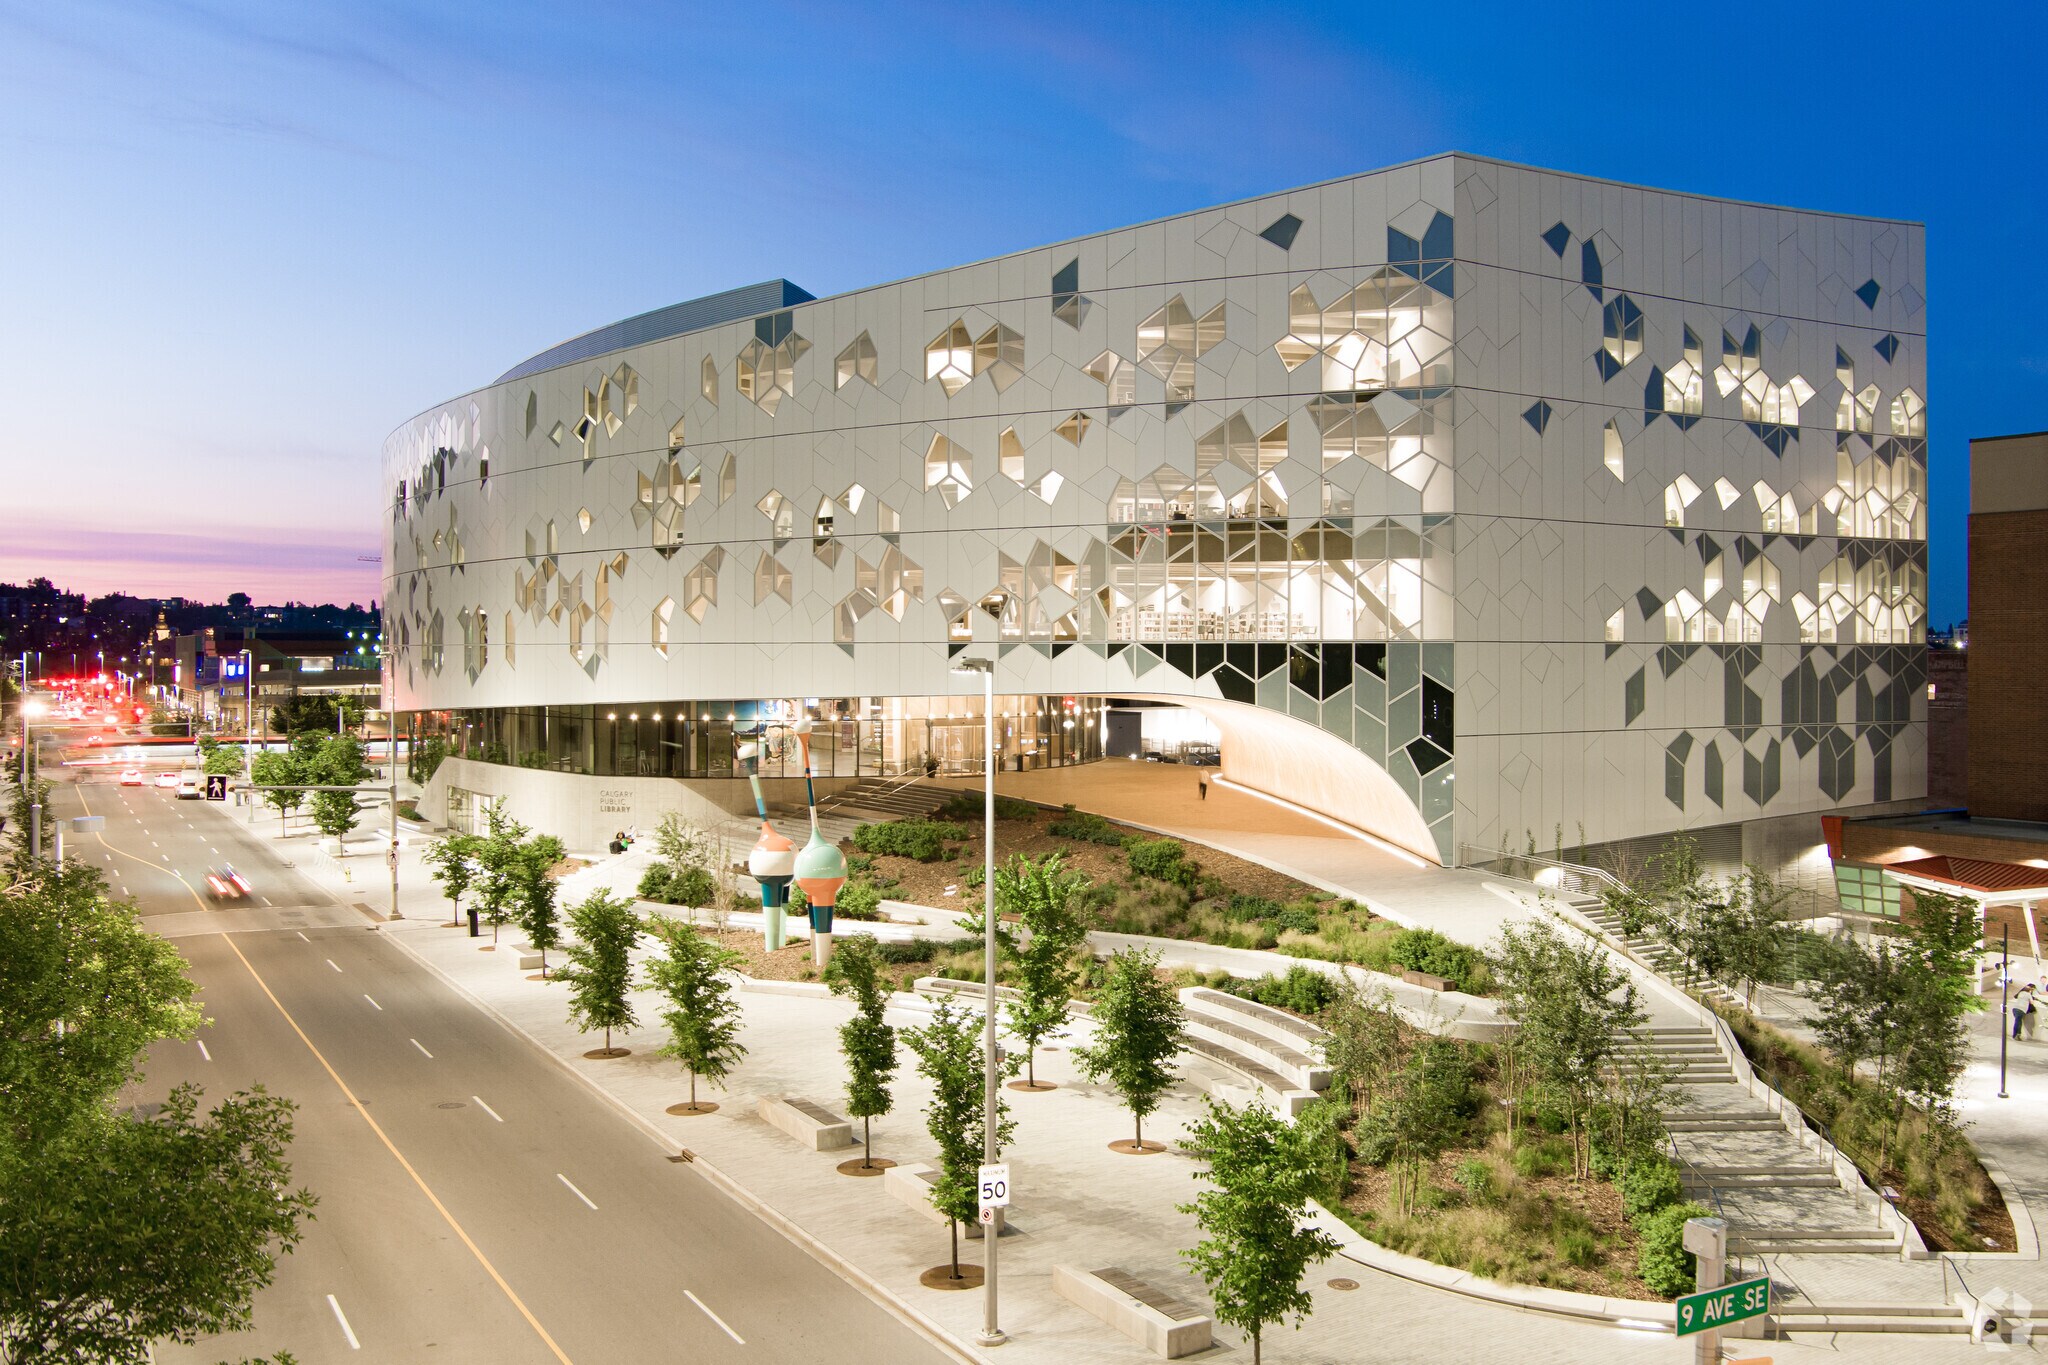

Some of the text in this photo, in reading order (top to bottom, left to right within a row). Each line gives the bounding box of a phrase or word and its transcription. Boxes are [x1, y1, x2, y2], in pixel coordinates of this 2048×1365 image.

[983, 1181, 1006, 1200] 50
[1681, 1285, 1765, 1328] 9 AVE SE
